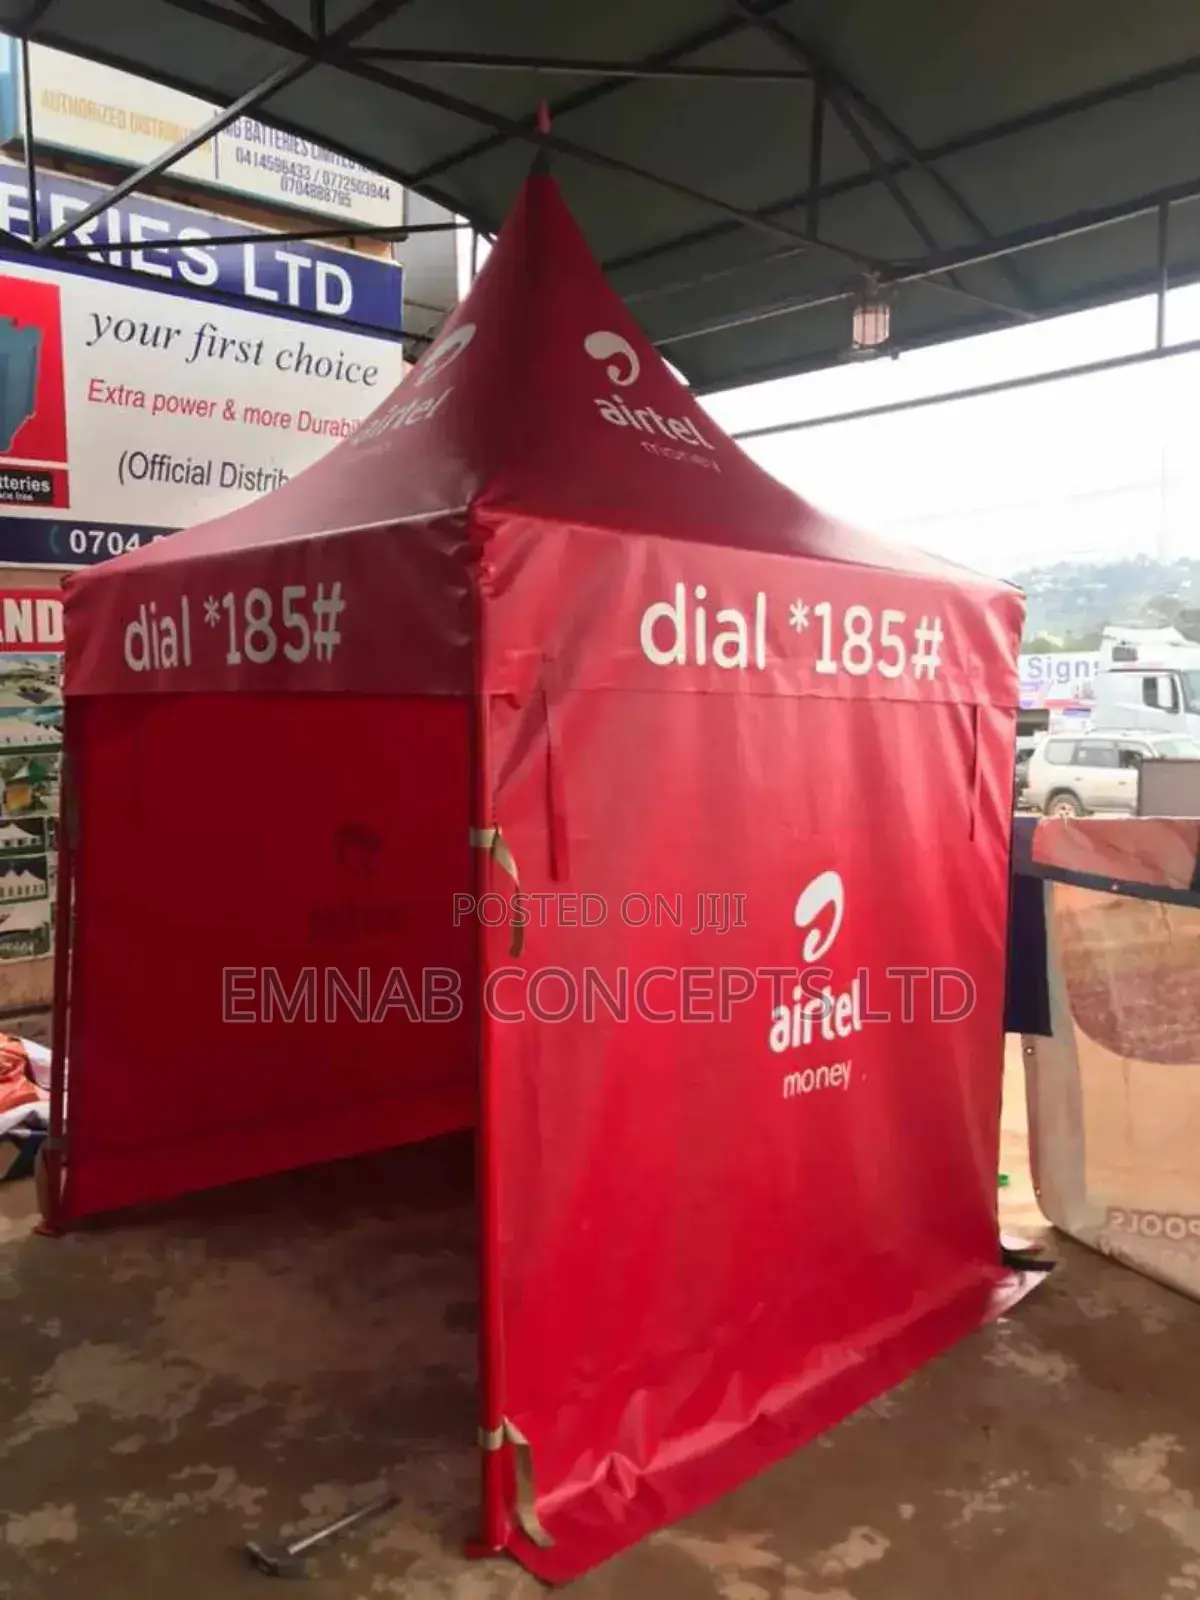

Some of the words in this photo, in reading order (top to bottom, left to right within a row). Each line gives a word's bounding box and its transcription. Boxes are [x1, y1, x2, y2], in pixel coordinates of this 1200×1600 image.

[245, 119, 309, 157] BATTERIES
[243, 243, 353, 315] LTD
[86, 313, 182, 349] your
[184, 322, 264, 366] first
[276, 341, 379, 387] choice
[88, 378, 146, 408] Extra
[152, 393, 217, 418] power
[222, 398, 236, 421] &
[243, 406, 292, 429] more
[593, 394, 717, 450] airtel
[118, 449, 212, 486] (Official
[0, 598, 64, 643] ND
[123, 594, 192, 672] dial
[640, 581, 767, 670] dial
[769, 978, 863, 1053] airtel
[783, 1060, 853, 1099] money
